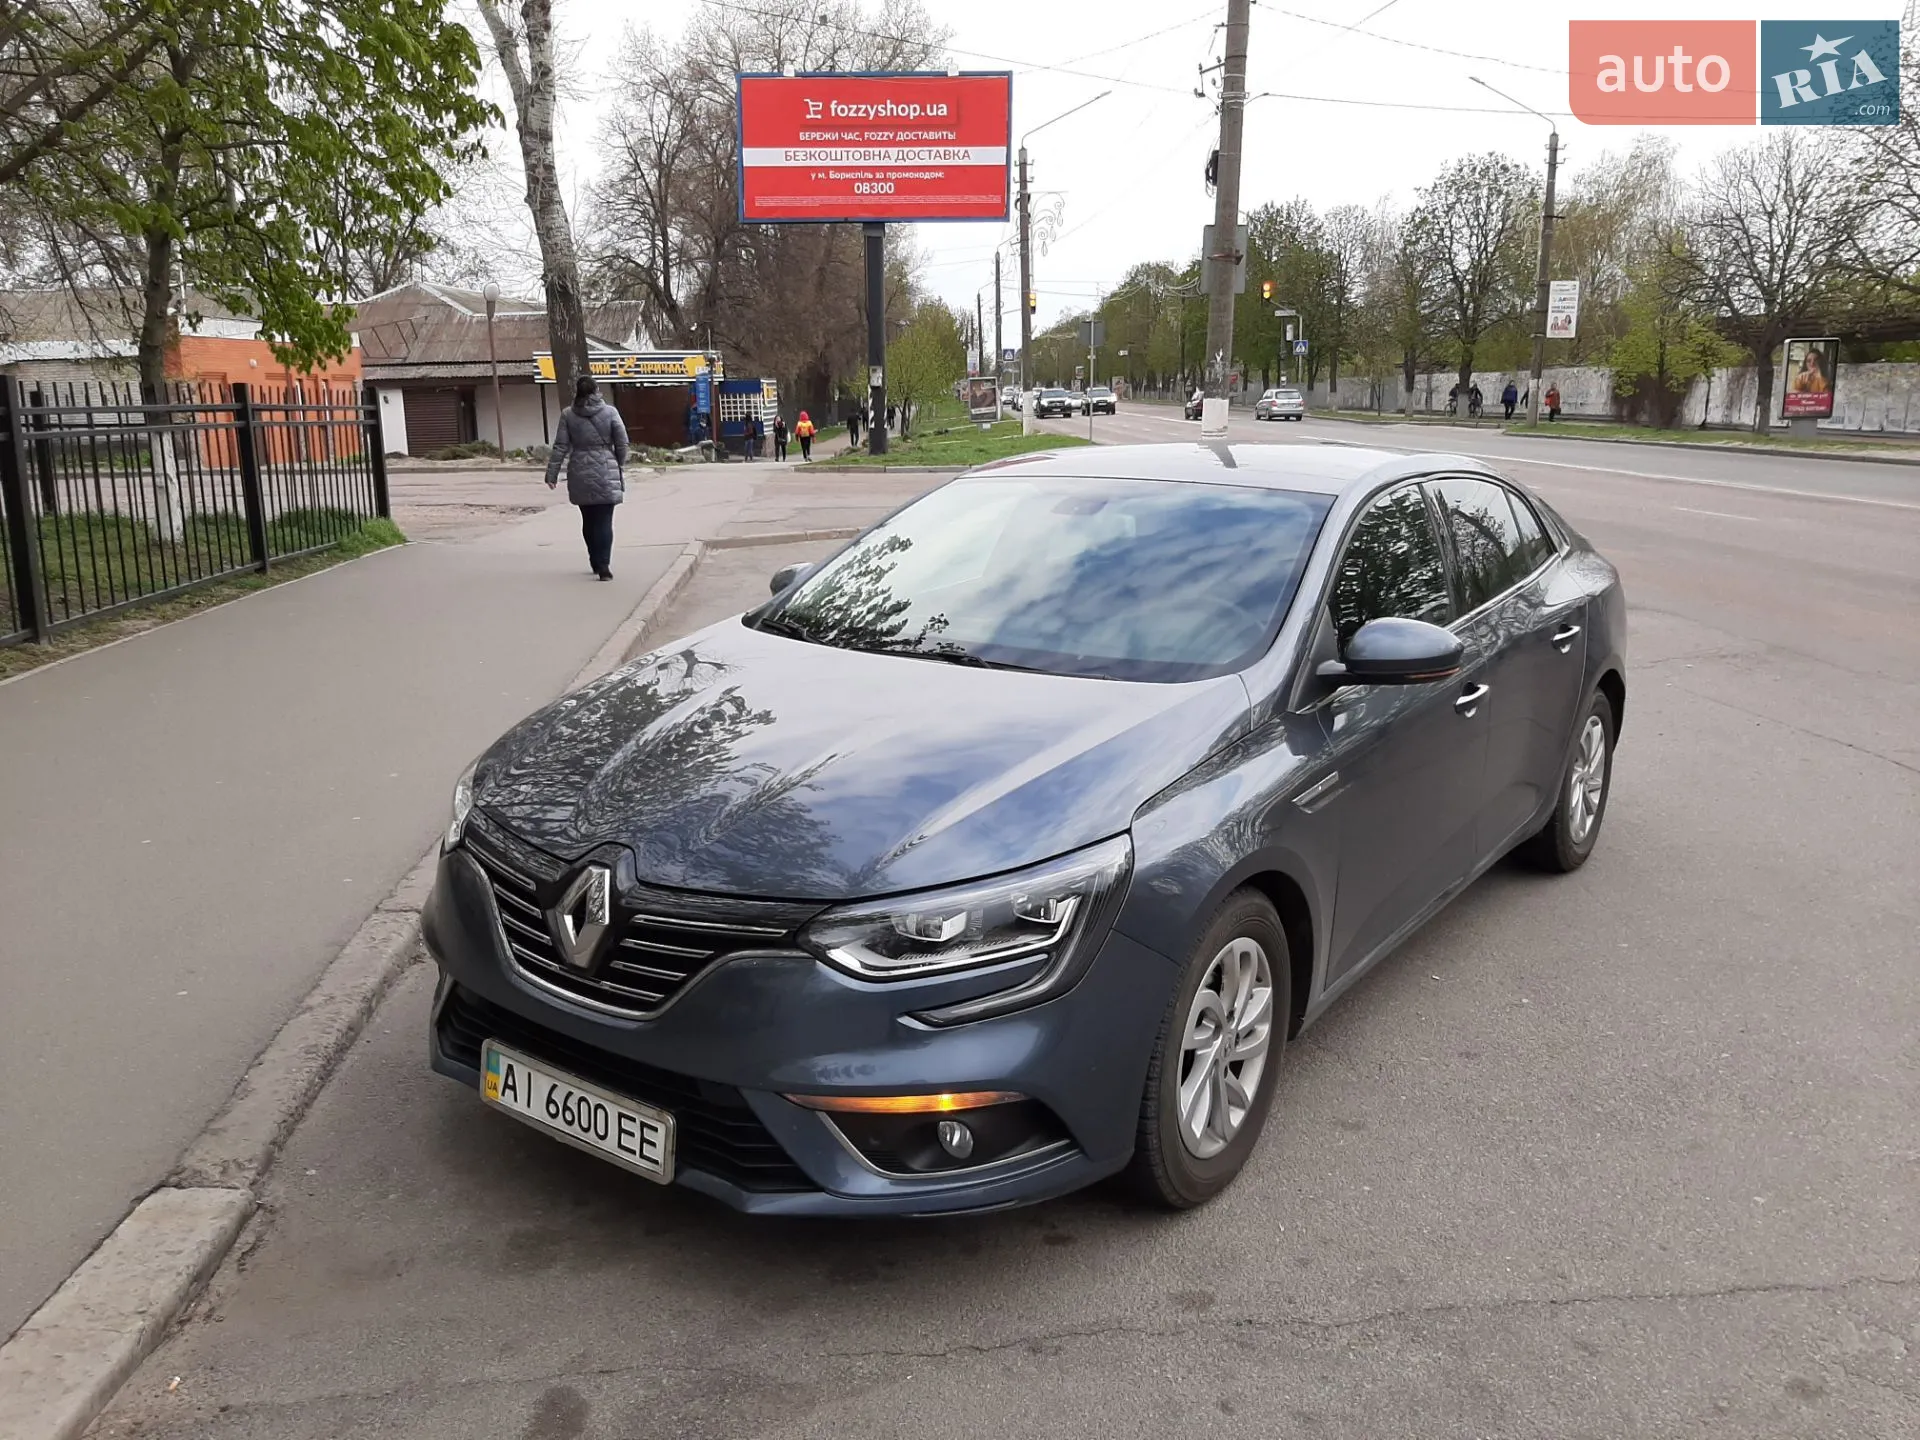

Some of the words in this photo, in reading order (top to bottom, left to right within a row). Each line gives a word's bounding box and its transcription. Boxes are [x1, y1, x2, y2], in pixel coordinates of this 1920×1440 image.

[830, 100, 947, 120] fozzyshop.ua
[799, 131, 838, 141] БЕРЕЖИ
[840, 131, 862, 142] ЧАС,
[864, 131, 894, 141] FOZZY
[896, 130, 956, 142] ДОСТАВИТЬ!
[784, 149, 892, 162] БЕЗКОШТОВНА
[895, 149, 971, 163] ДОСТАВКА
[829, 170, 873, 180] Бориспіль
[887, 171, 945, 180] промокодом:
[854, 182, 894, 194] 08300
[487, 1080, 498, 1093] UA
[501, 1063, 532, 1108] AI
[546, 1083, 609, 1141] 6600
[618, 1111, 660, 1165] EE
